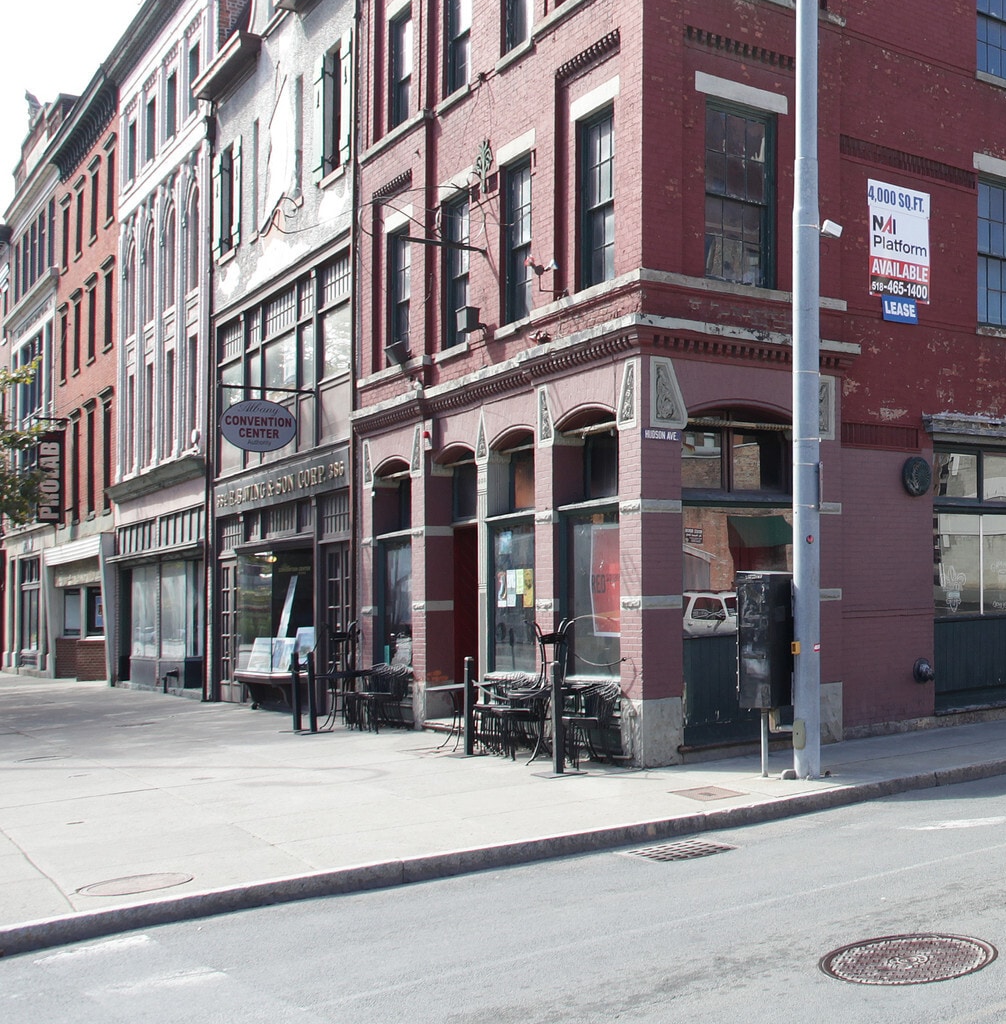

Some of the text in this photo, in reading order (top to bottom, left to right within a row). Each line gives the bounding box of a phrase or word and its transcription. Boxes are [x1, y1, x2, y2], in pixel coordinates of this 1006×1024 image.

[868, 185, 925, 213] 4,000 SQ.FT.
[872, 214, 896, 235] NAI
[873, 234, 927, 257] Platform
[872, 258, 929, 283] AVAILABLE
[871, 280, 928, 299] 518-465-1400
[884, 300, 917, 318] LEASE
[238, 402, 280, 416] Albany
[225, 415, 292, 428] CONVENTION
[238, 428, 280, 439] CENTER
[644, 429, 666, 440] HUDSON
[275, 473, 296, 495] SON
